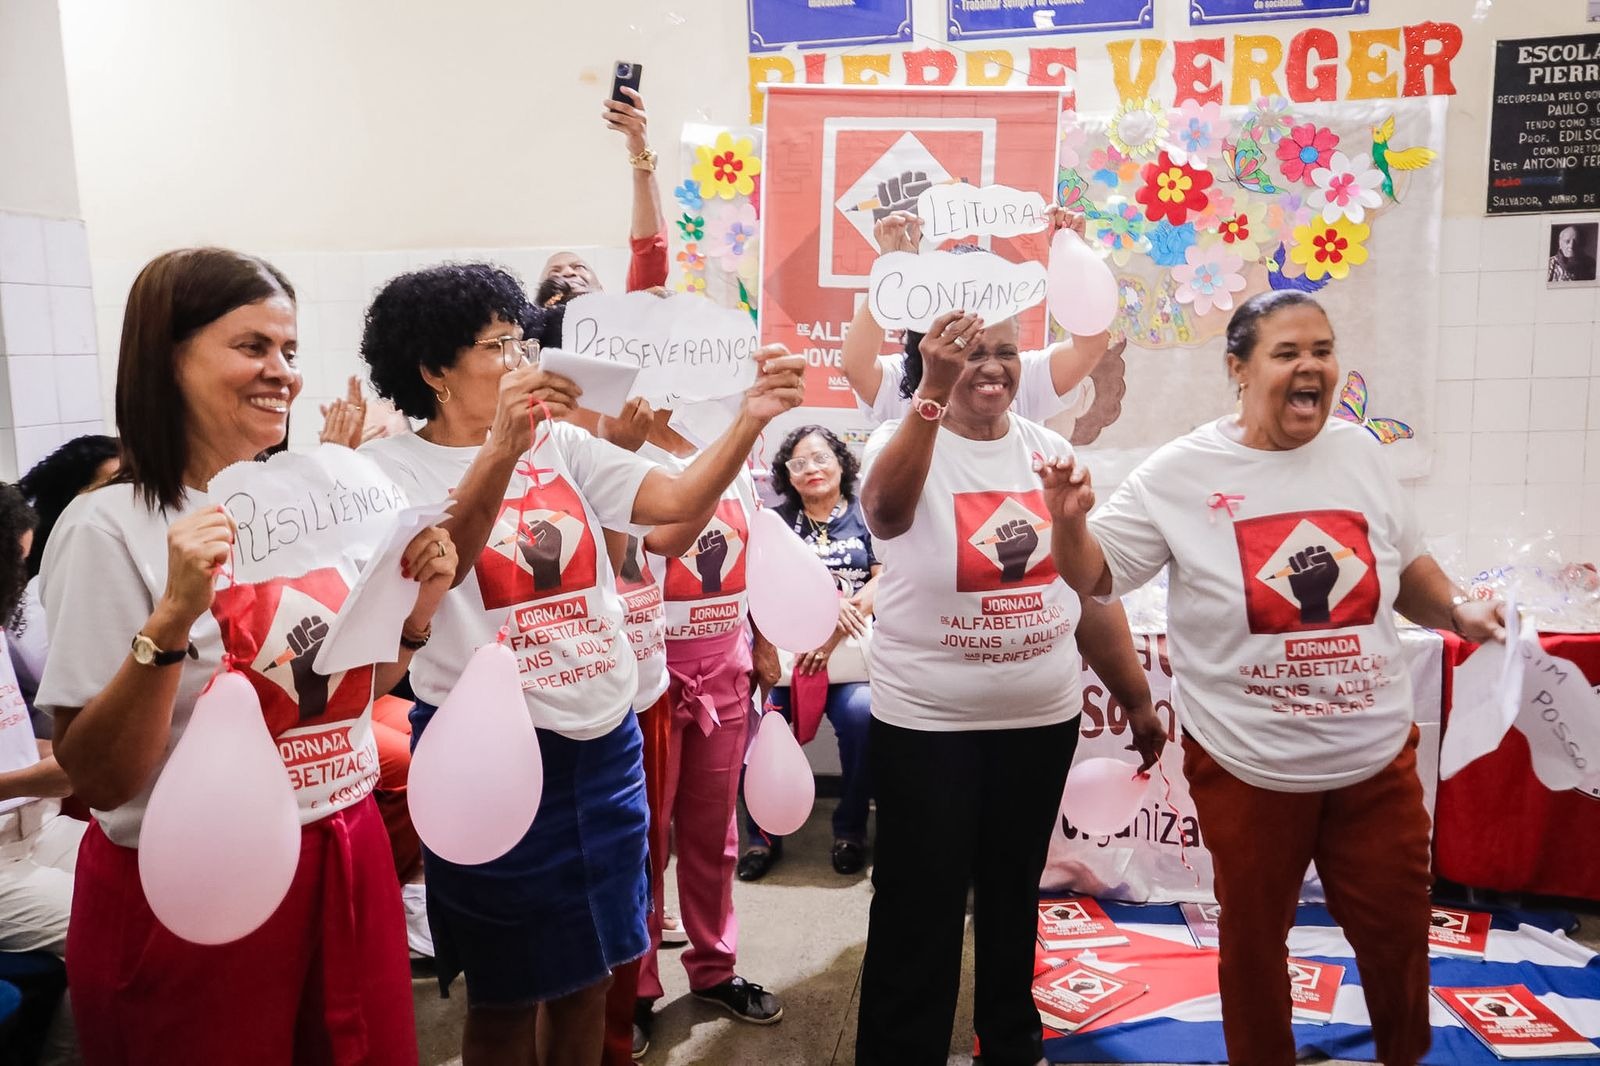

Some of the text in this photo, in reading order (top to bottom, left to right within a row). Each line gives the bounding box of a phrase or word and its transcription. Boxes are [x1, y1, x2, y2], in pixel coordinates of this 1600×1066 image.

[1106, 20, 1463, 108] VERGER
[1528, 64, 1600, 85] PIERR
[1497, 93, 1555, 104] RECUPERADA
[1558, 91, 1582, 101] PELO
[1547, 102, 1588, 116] PAULO
[1525, 120, 1556, 130] TENDO
[1559, 119, 1585, 128] COMO
[1533, 146, 1559, 156] COMO
[1522, 156, 1577, 170] ANTONIO
[1548, 195, 1578, 204] JUNHO
[1583, 194, 1596, 203] DE
[930, 194, 1037, 237] LEITURA
[875, 271, 1047, 321] CONFIANÇA
[796, 322, 811, 336] DE
[575, 317, 759, 377] PERSEVERANÇA
[828, 376, 850, 391] NAS
[224, 479, 405, 566] RESILIÊNCIA
[691, 604, 737, 621] JORNADA
[984, 595, 1042, 612] JORNADA
[518, 600, 585, 628] JORNADA
[940, 634, 1002, 649] JOVENS
[1023, 619, 1070, 646] ADULTOS
[1288, 638, 1359, 658] JORNADA
[536, 656, 617, 690] PERIFERIAS
[1245, 684, 1310, 699] JOVENS
[1292, 694, 1376, 717] PERIFERIS
[1531, 689, 1588, 770] POSSO
[280, 732, 348, 762] ORNADA
